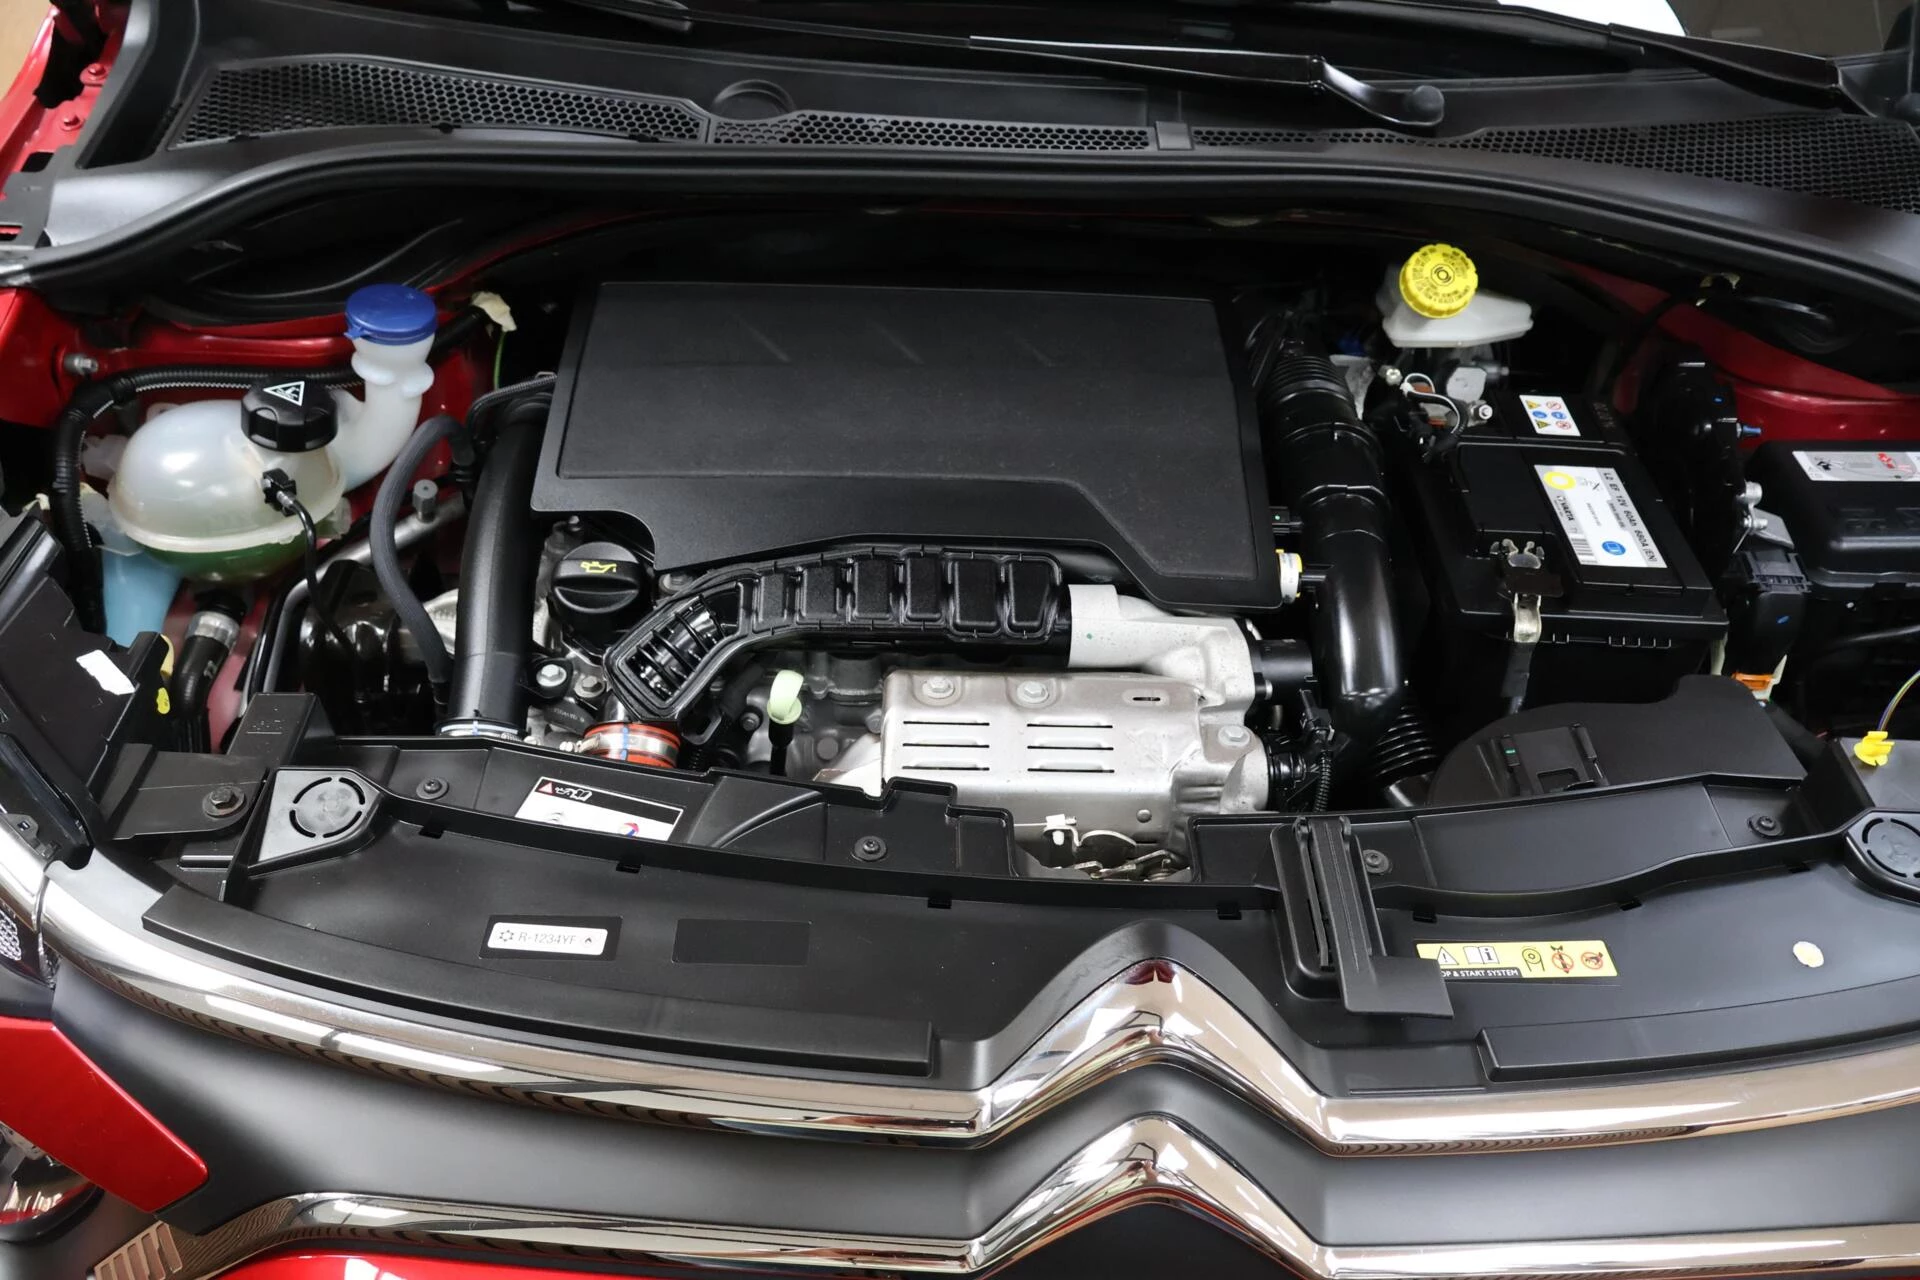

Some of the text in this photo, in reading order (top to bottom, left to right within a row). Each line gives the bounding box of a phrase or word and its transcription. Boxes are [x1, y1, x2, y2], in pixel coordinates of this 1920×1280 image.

[1615, 495, 1628, 508] 12V
[518, 931, 577, 945] R-1234YF
[1460, 970, 1486, 978] START
[1486, 969, 1519, 977] SYSTEM
